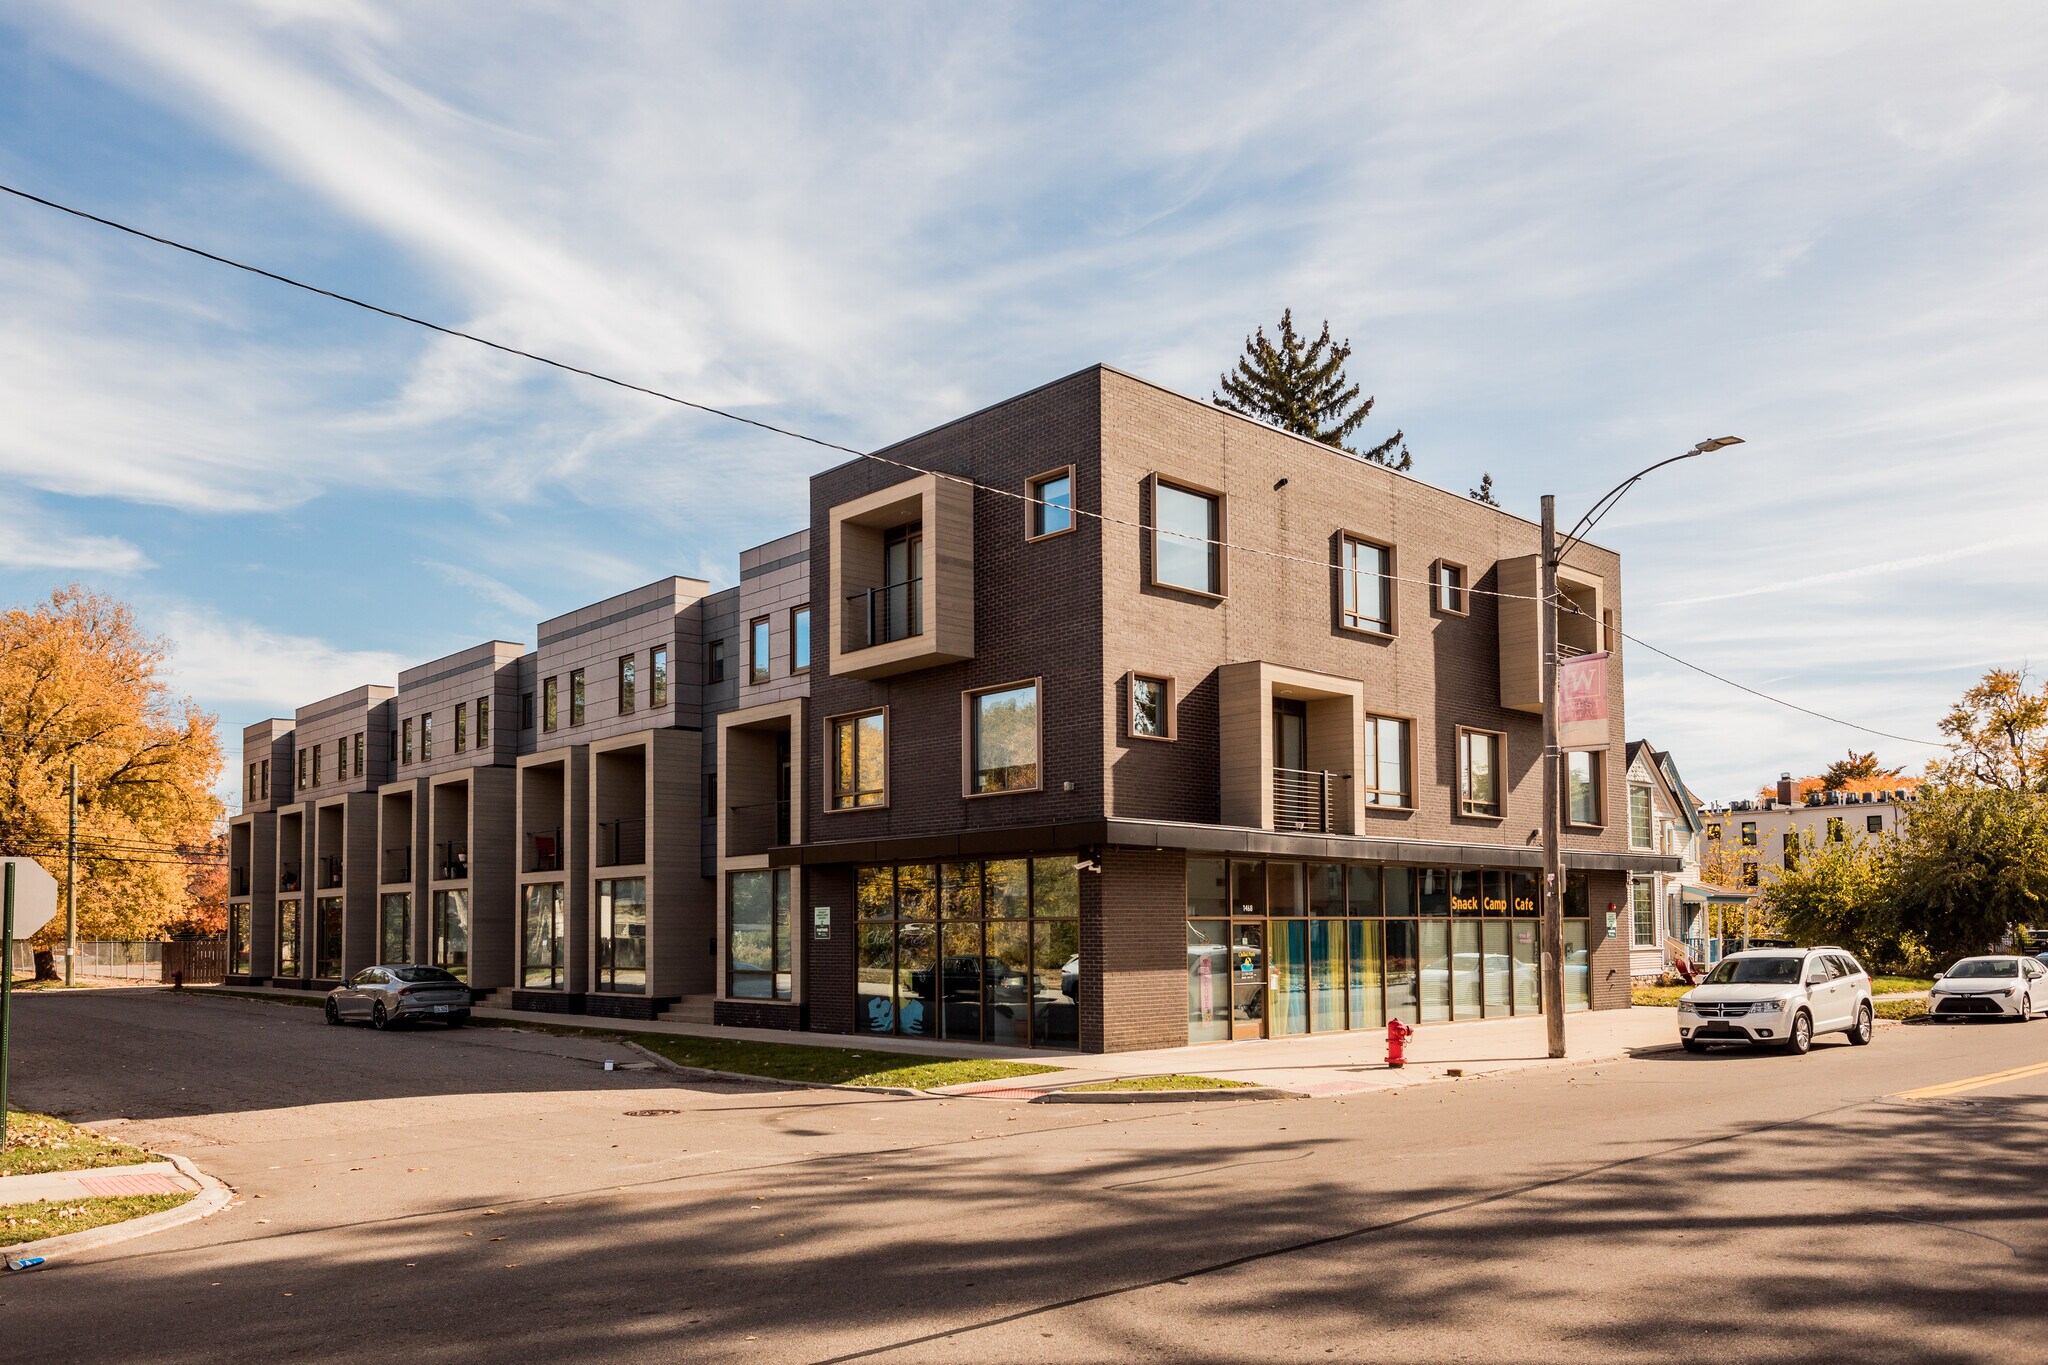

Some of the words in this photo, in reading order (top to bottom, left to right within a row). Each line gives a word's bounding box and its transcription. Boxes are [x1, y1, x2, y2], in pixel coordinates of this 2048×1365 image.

[1571, 668, 1597, 692] W
[1566, 699, 1600, 712] WEST
[1452, 896, 1478, 910] Snack
[1484, 896, 1507, 913] Camp
[1515, 897, 1534, 911] Cafe
